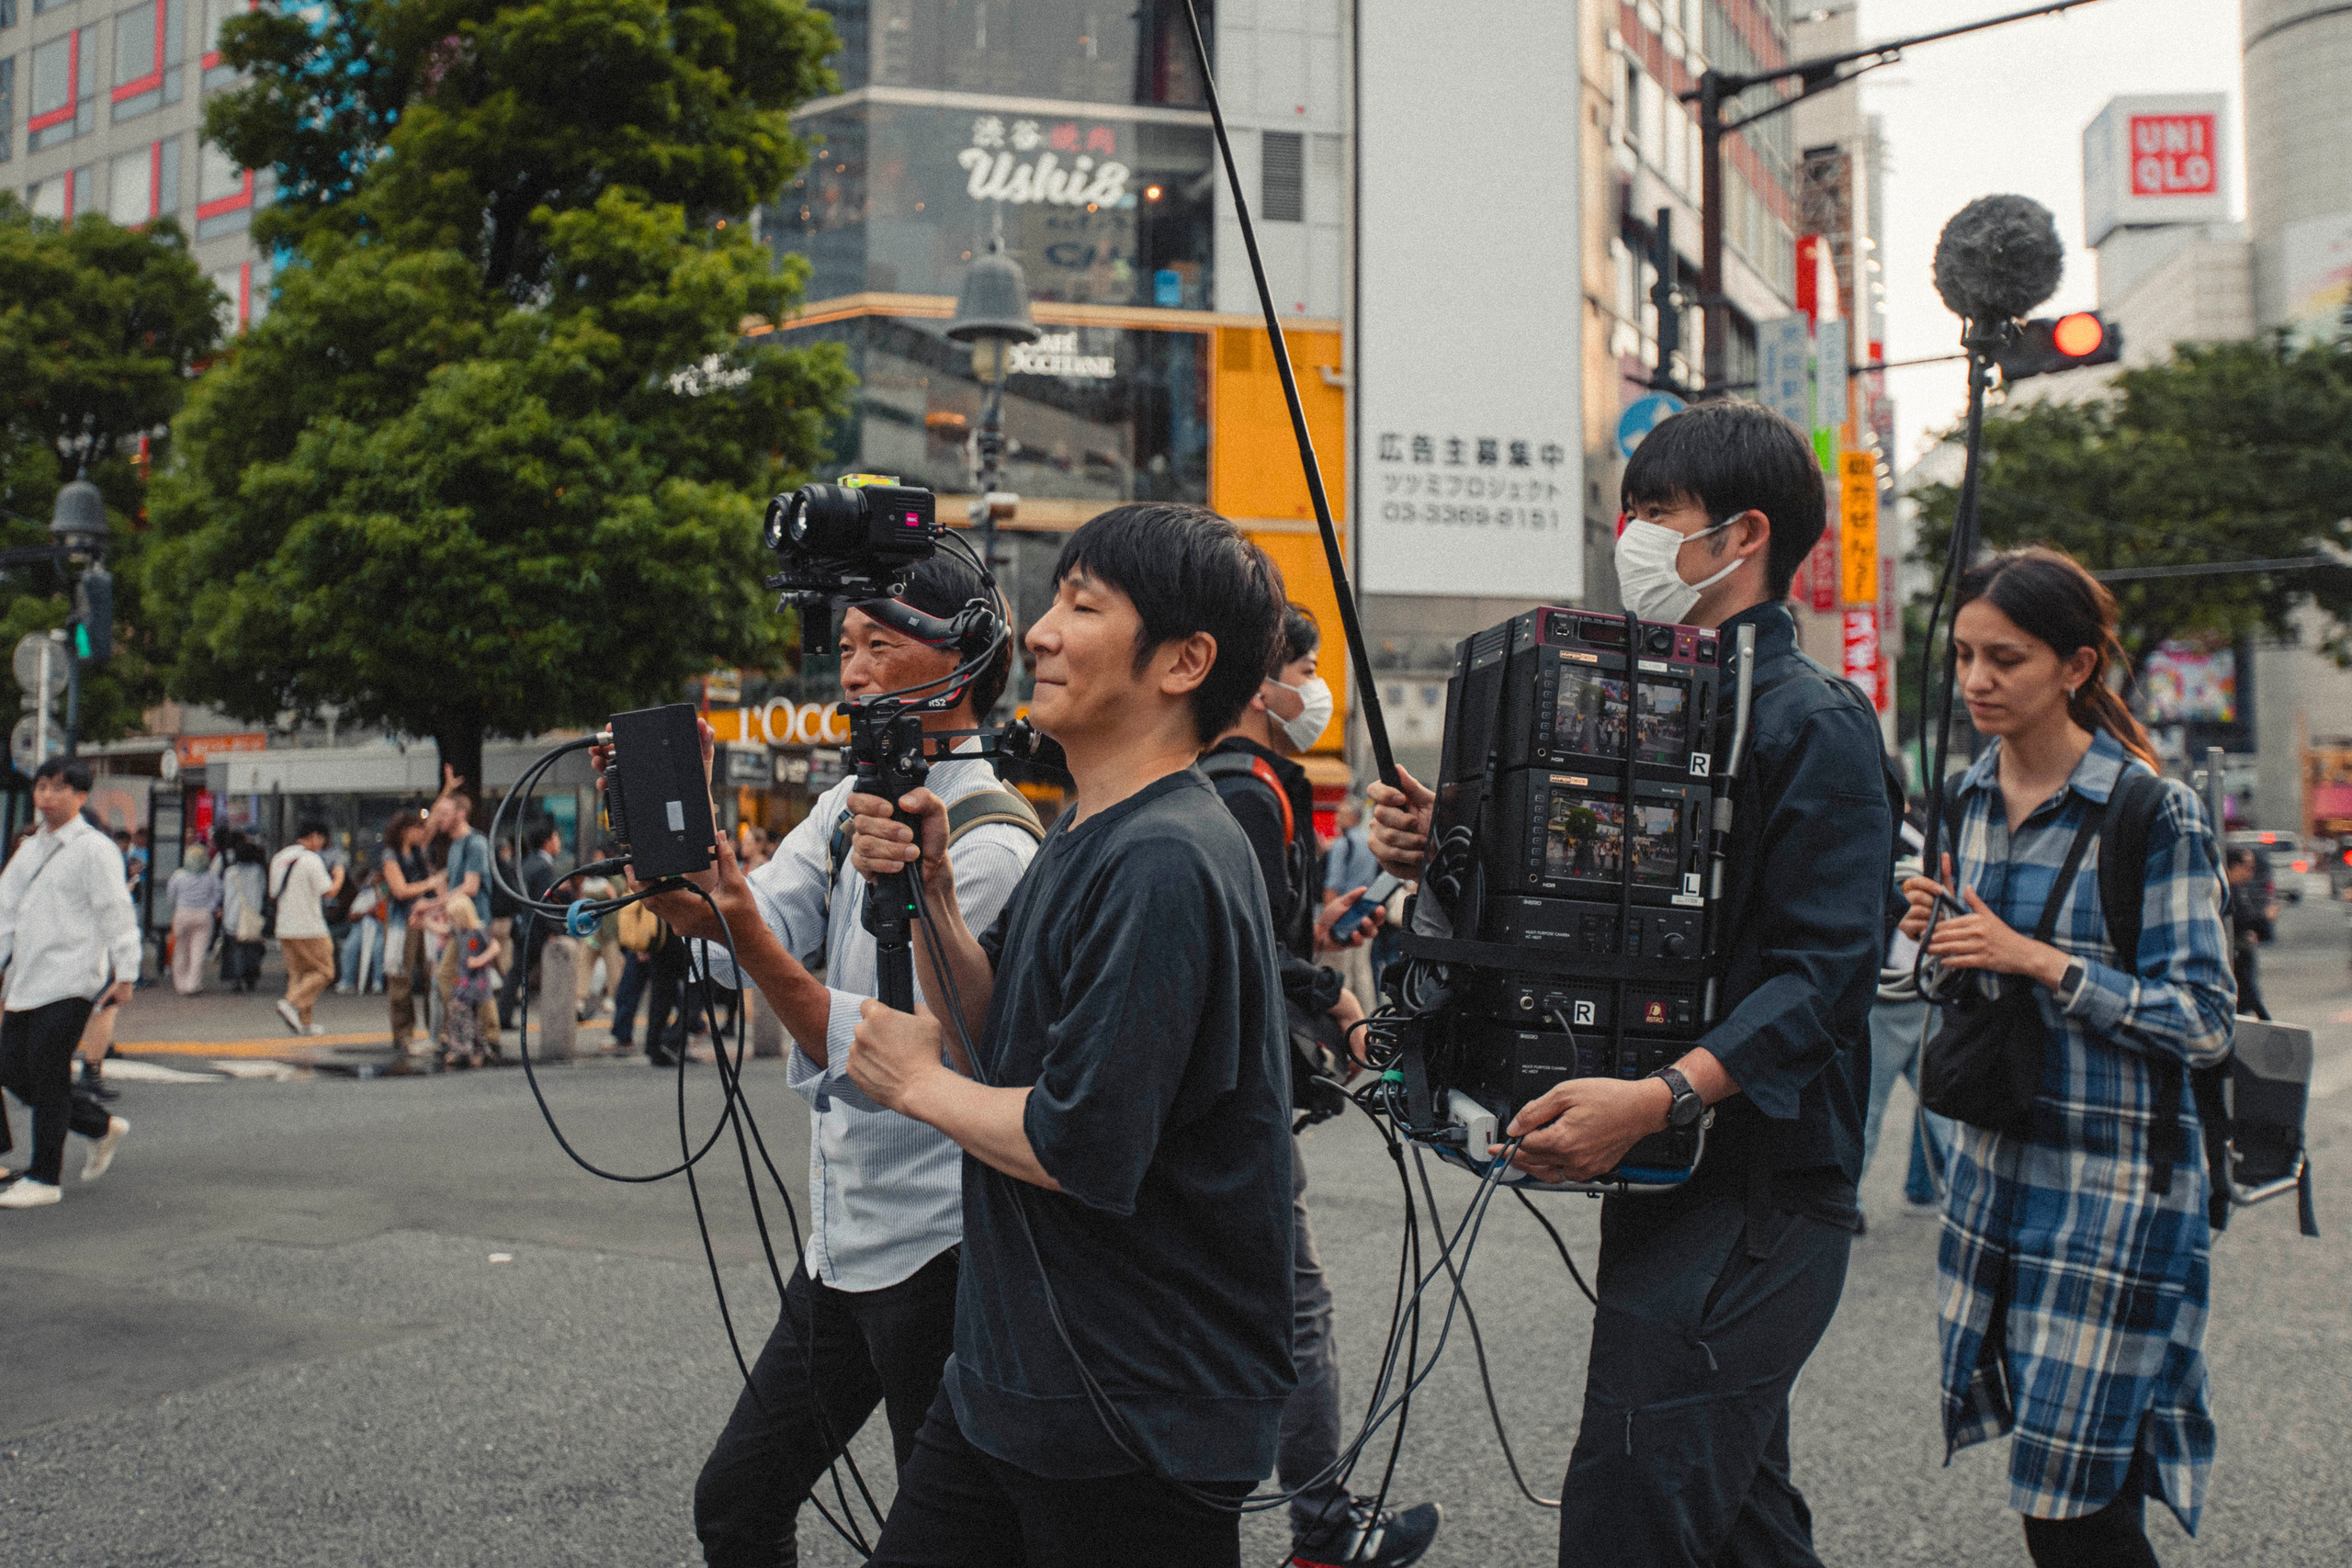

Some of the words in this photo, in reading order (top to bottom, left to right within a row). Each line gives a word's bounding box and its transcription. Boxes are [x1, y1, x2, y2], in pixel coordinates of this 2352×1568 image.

[2135, 120, 2203, 153] UNI
[2137, 154, 2210, 191] QLO
[1380, 434, 1565, 469] 広告主募集中
[928, 698, 946, 707] RS2
[739, 696, 848, 746] L'OCC
[1692, 755, 1707, 773] R
[1686, 876, 1697, 894] L
[1577, 1004, 1591, 1022] R
